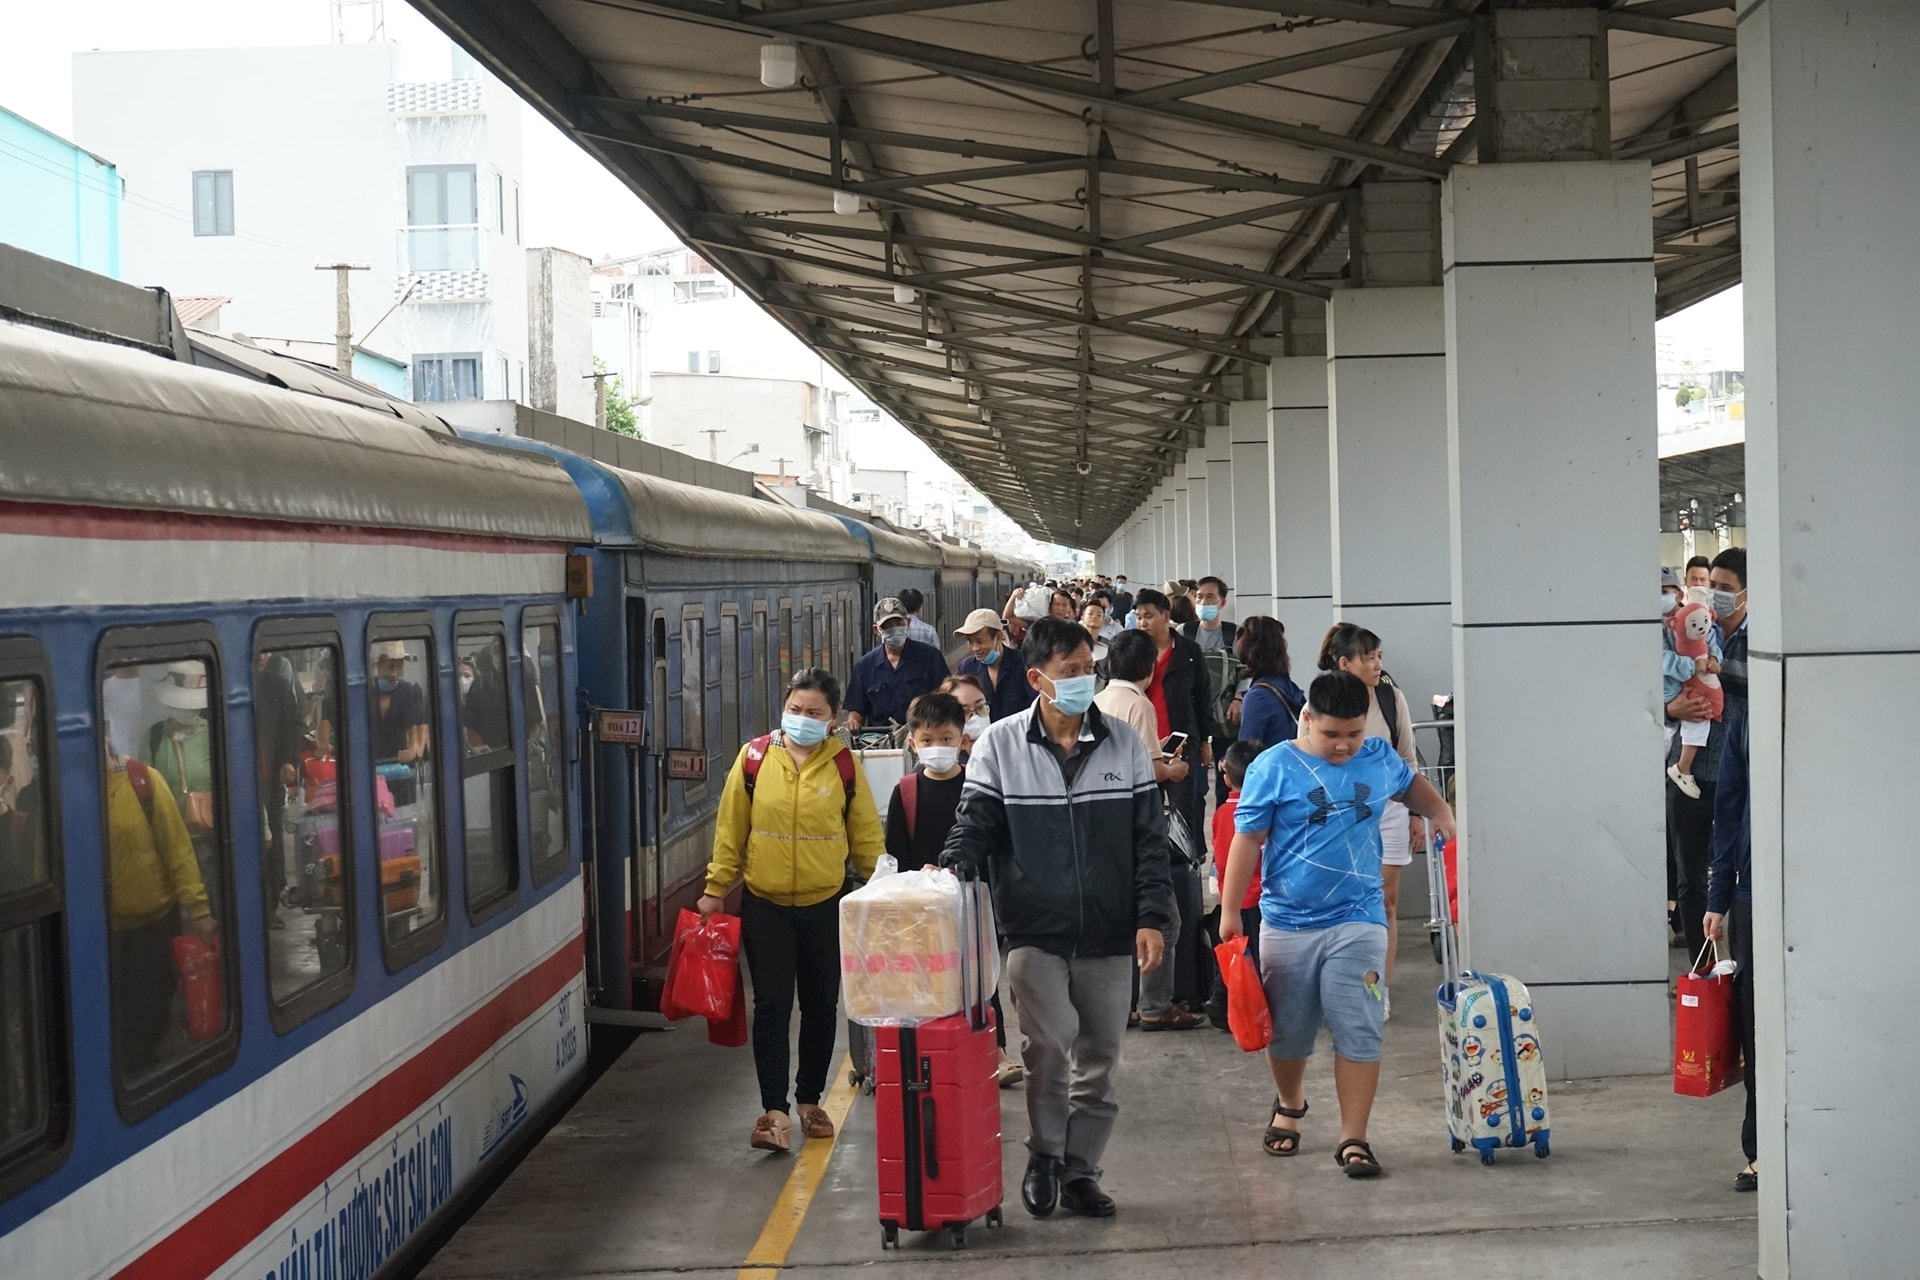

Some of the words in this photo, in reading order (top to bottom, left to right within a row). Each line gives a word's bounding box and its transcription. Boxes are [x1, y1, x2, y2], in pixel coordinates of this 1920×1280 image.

[608, 723, 624, 732] TOA
[625, 721, 637, 733] 12
[673, 760, 687, 768] TOA
[689, 758, 703, 772] 11
[559, 990, 571, 1028] SRT
[555, 1040, 561, 1074] A
[385, 1131, 406, 1258] SẮT
[409, 1124, 427, 1234] SÀI
[430, 1102, 452, 1212] GÒN
